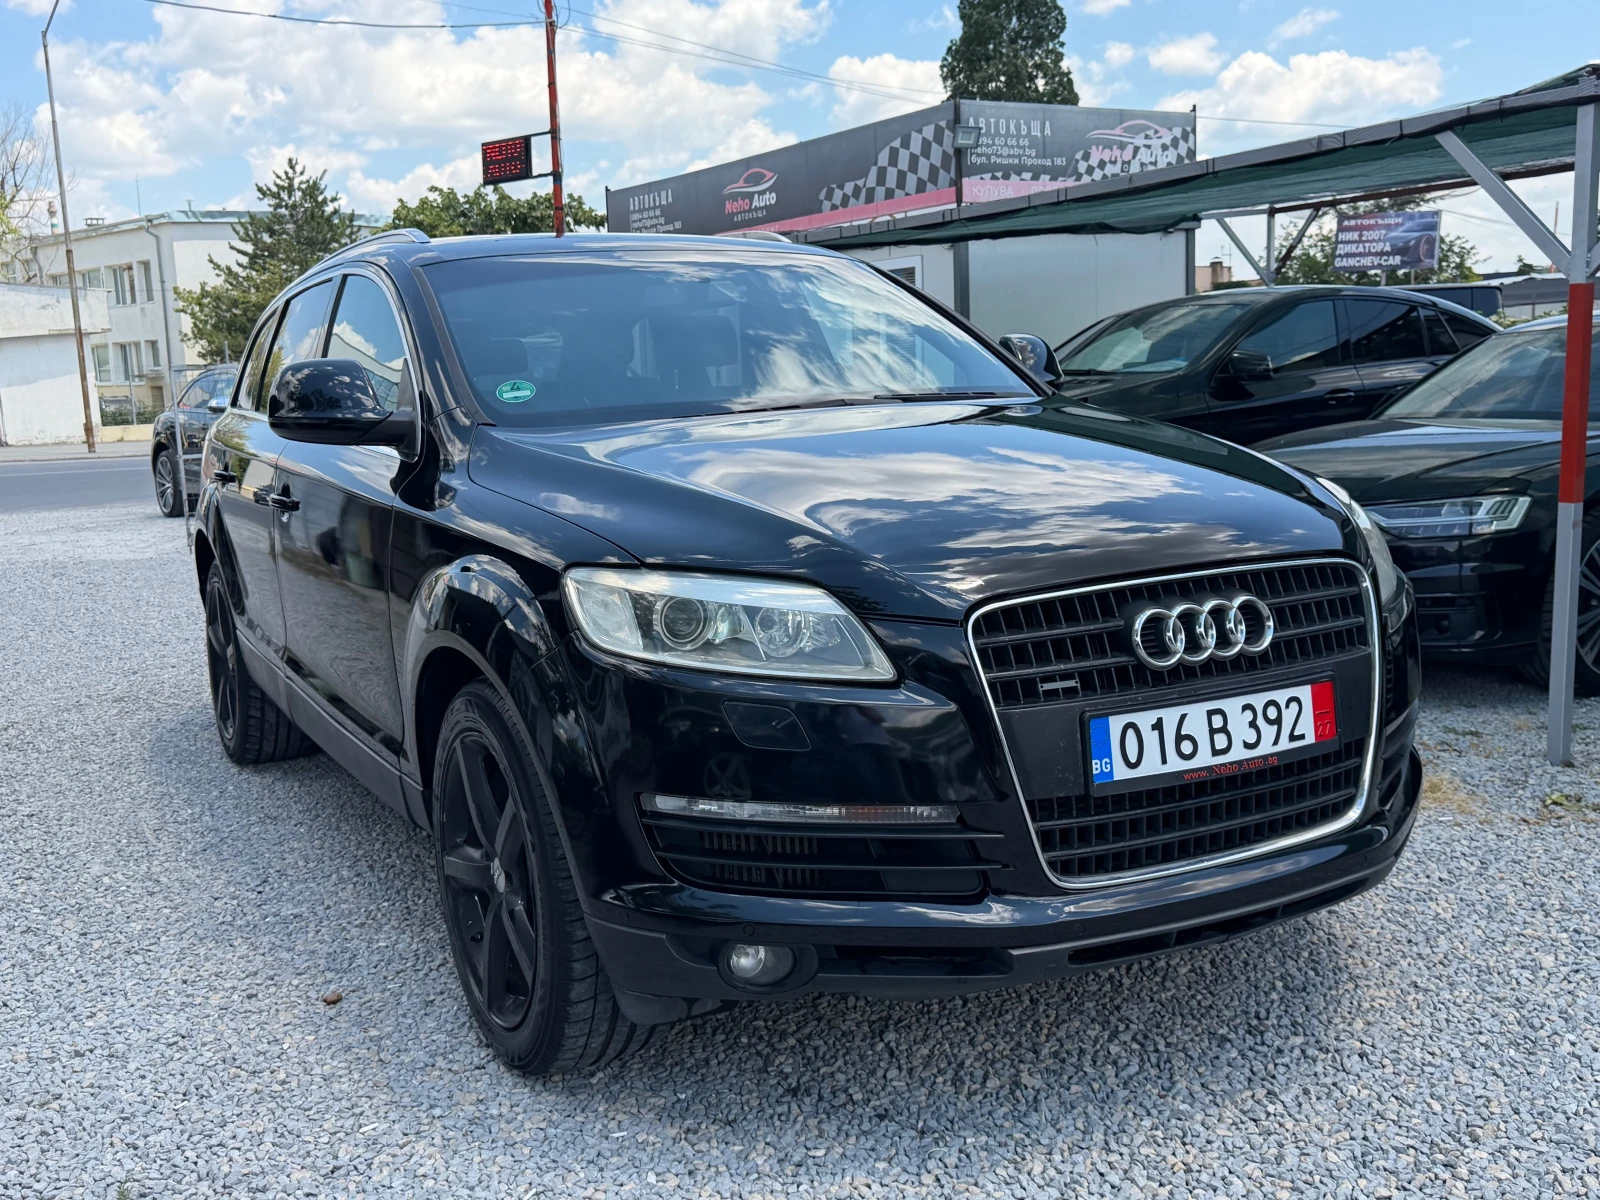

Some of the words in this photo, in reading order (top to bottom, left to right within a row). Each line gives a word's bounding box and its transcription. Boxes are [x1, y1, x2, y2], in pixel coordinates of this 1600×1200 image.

[968, 117, 1051, 137] АВТОКЪЩА
[994, 137, 1005, 146] 60
[1007, 138, 1017, 147] 66
[1019, 138, 1029, 147] 66
[971, 154, 989, 165] бул.
[990, 155, 1019, 165] Ришки
[1021, 156, 1052, 167] Проход
[1053, 157, 1067, 166] 183
[972, 185, 1014, 196] КУПУВА
[630, 189, 673, 211] АВТОКЪЩА
[725, 196, 750, 214] Neho
[751, 191, 777, 209] Auto
[733, 209, 767, 222] АВТОКЪЩА
[1338, 231, 1360, 242] НИК
[1362, 230, 1386, 241] 2007
[1335, 242, 1391, 256] ДИКАТОРА
[1334, 255, 1402, 268] GANCHEV-CAR
[1092, 757, 1112, 775] BG
[1212, 763, 1239, 776] Neho
[1240, 758, 1264, 771] Auto
